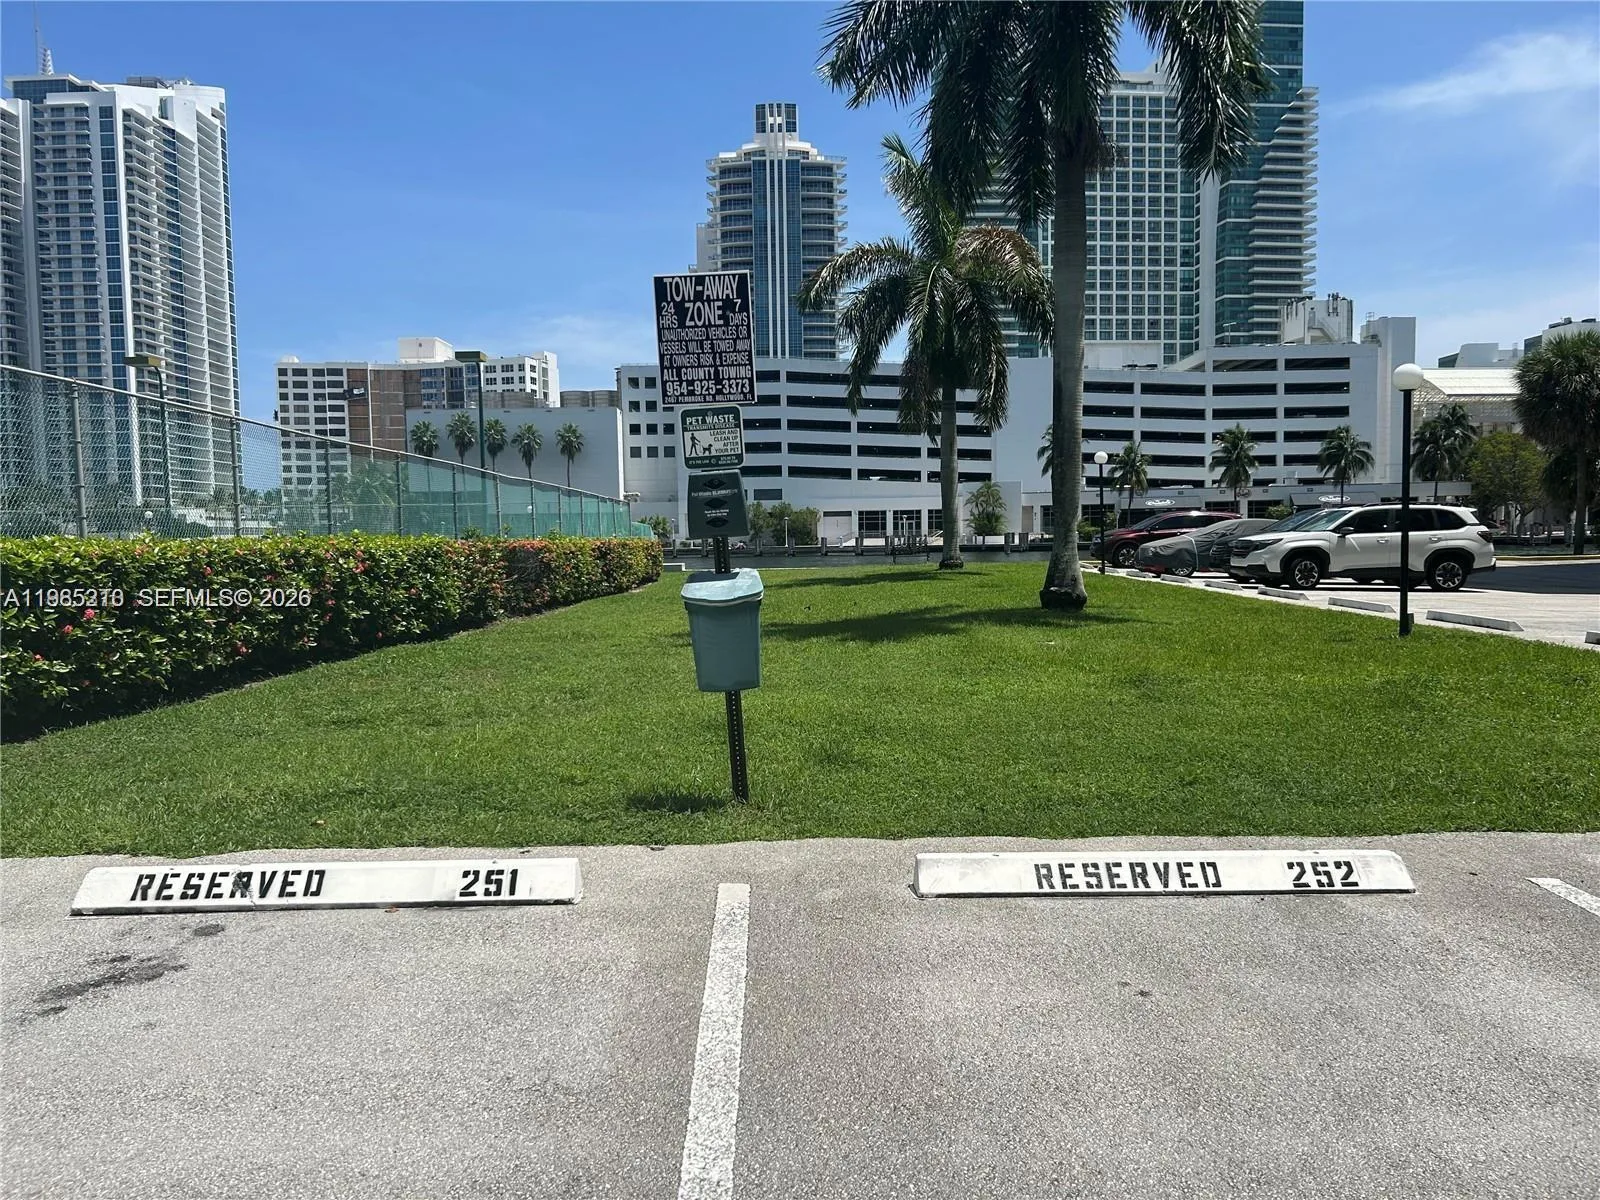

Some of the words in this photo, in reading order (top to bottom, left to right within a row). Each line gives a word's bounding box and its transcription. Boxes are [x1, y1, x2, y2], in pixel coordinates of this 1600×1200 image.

[663, 275, 739, 301] TOW-AWAY
[661, 302, 675, 315] 24
[733, 299, 741, 312] 7
[684, 301, 724, 326] ZONE
[729, 312, 748, 326] DAYS
[660, 315, 679, 328] HRS
[661, 327, 707, 341] UNAUTHORIZED
[708, 326, 737, 339] VEHICLES
[738, 326, 748, 338] OR
[660, 341, 687, 355] VESSELS
[687, 341, 702, 353] WILL
[703, 341, 712, 353] BE
[714, 340, 735, 352] TOWED
[736, 339, 751, 351] AWAY
[663, 355, 671, 367] AT
[672, 354, 699, 367] OWNERS
[700, 353, 714, 366] RISK
[716, 352, 721, 365] &
[722, 352, 749, 365] EXPENSE
[663, 368, 679, 381] ALL
[681, 367, 715, 380] COUNTY
[718, 365, 752, 379] TOWING
[666, 379, 750, 396] 954-925-3373
[686, 416, 703, 425] PET
[705, 414, 735, 424] WASTE
[1034, 862, 1222, 890] RESERVED
[1286, 861, 1359, 888] 252
[130, 869, 326, 901] RESERVED
[459, 869, 519, 897] 251
